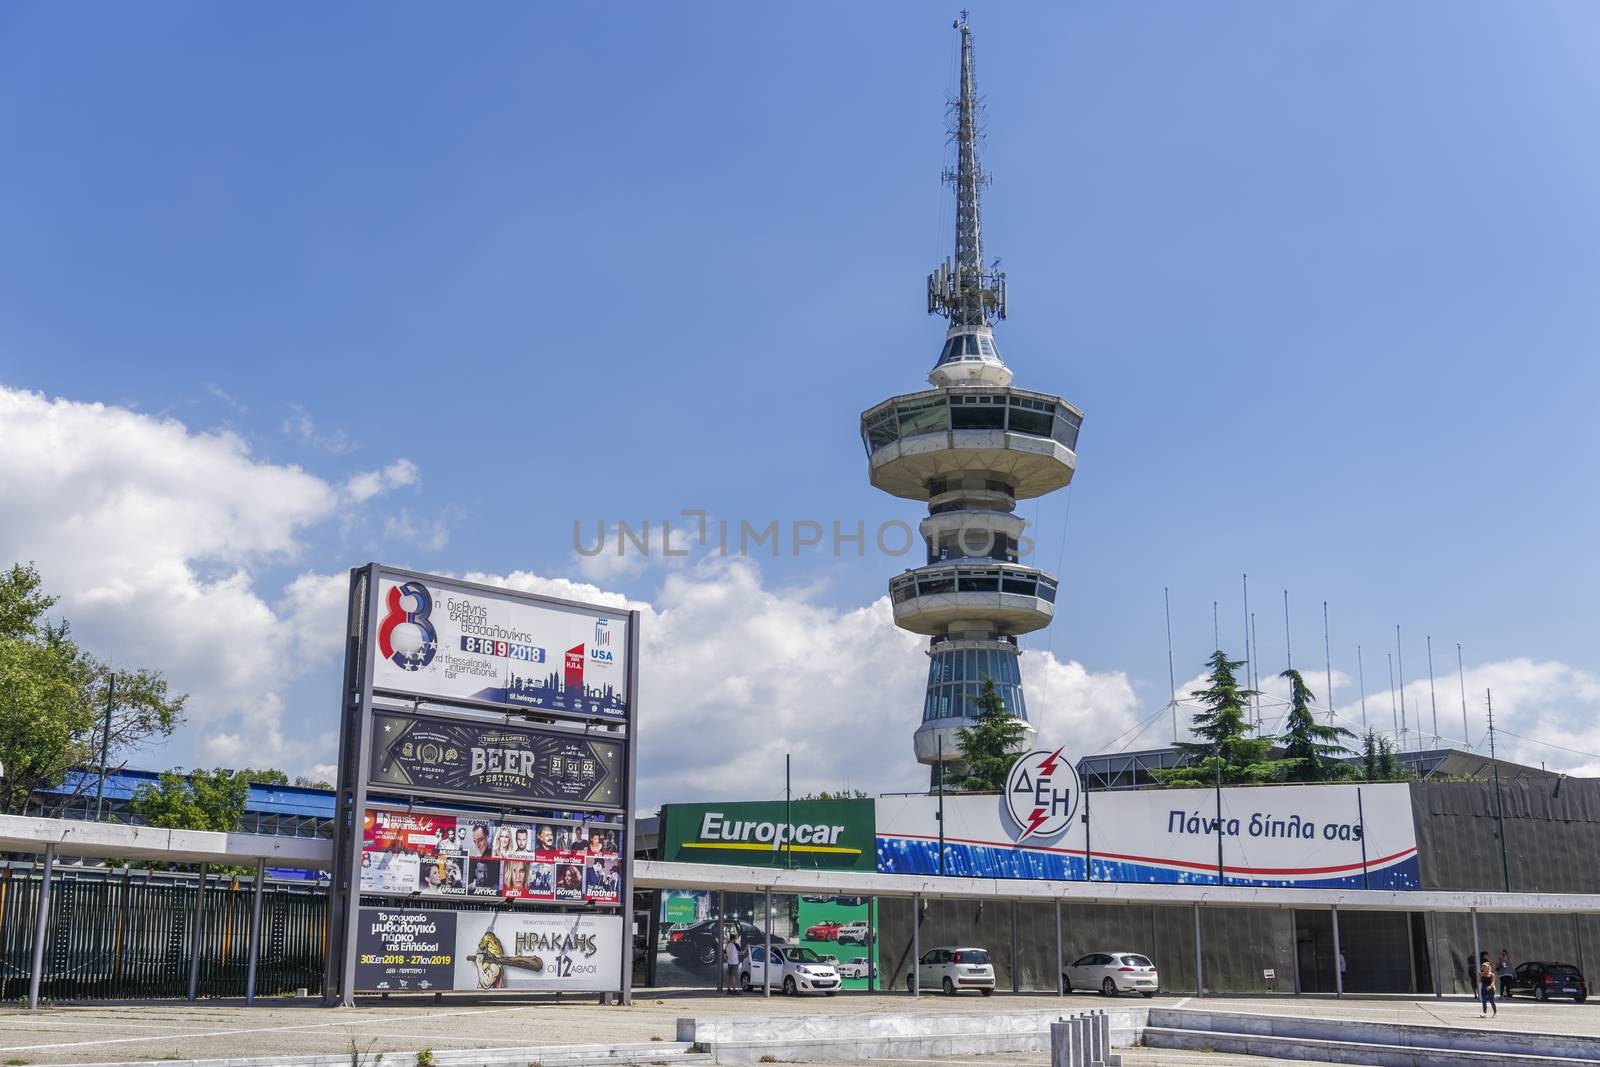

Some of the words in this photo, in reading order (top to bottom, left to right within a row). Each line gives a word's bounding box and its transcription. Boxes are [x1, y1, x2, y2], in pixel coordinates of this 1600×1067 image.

[509, 644, 541, 662] 2018
[591, 649, 613, 661] USA
[445, 655, 492, 670] thessaloniki
[445, 667, 457, 679] fair
[449, 663, 498, 679] international
[509, 693, 544, 705] tif.helexpo.gr
[469, 747, 535, 779] BEER
[552, 760, 561, 768] 31
[568, 763, 577, 771] 01
[583, 763, 593, 771] 02
[479, 774, 527, 787] FESTIVAL
[1012, 768, 1070, 817] ΔΕΗ
[391, 814, 416, 824] music
[700, 812, 845, 852] Europcar
[1248, 812, 1315, 839] δίπλα
[1323, 823, 1363, 842] σας
[586, 888, 617, 898] Brothers
[389, 913, 427, 924] κορυφαίο
[371, 920, 436, 936] μυθολογικό
[381, 931, 414, 944] πάρκο
[386, 943, 399, 951] της
[400, 942, 439, 952] Ελλάδος!
[555, 954, 573, 978] 12
